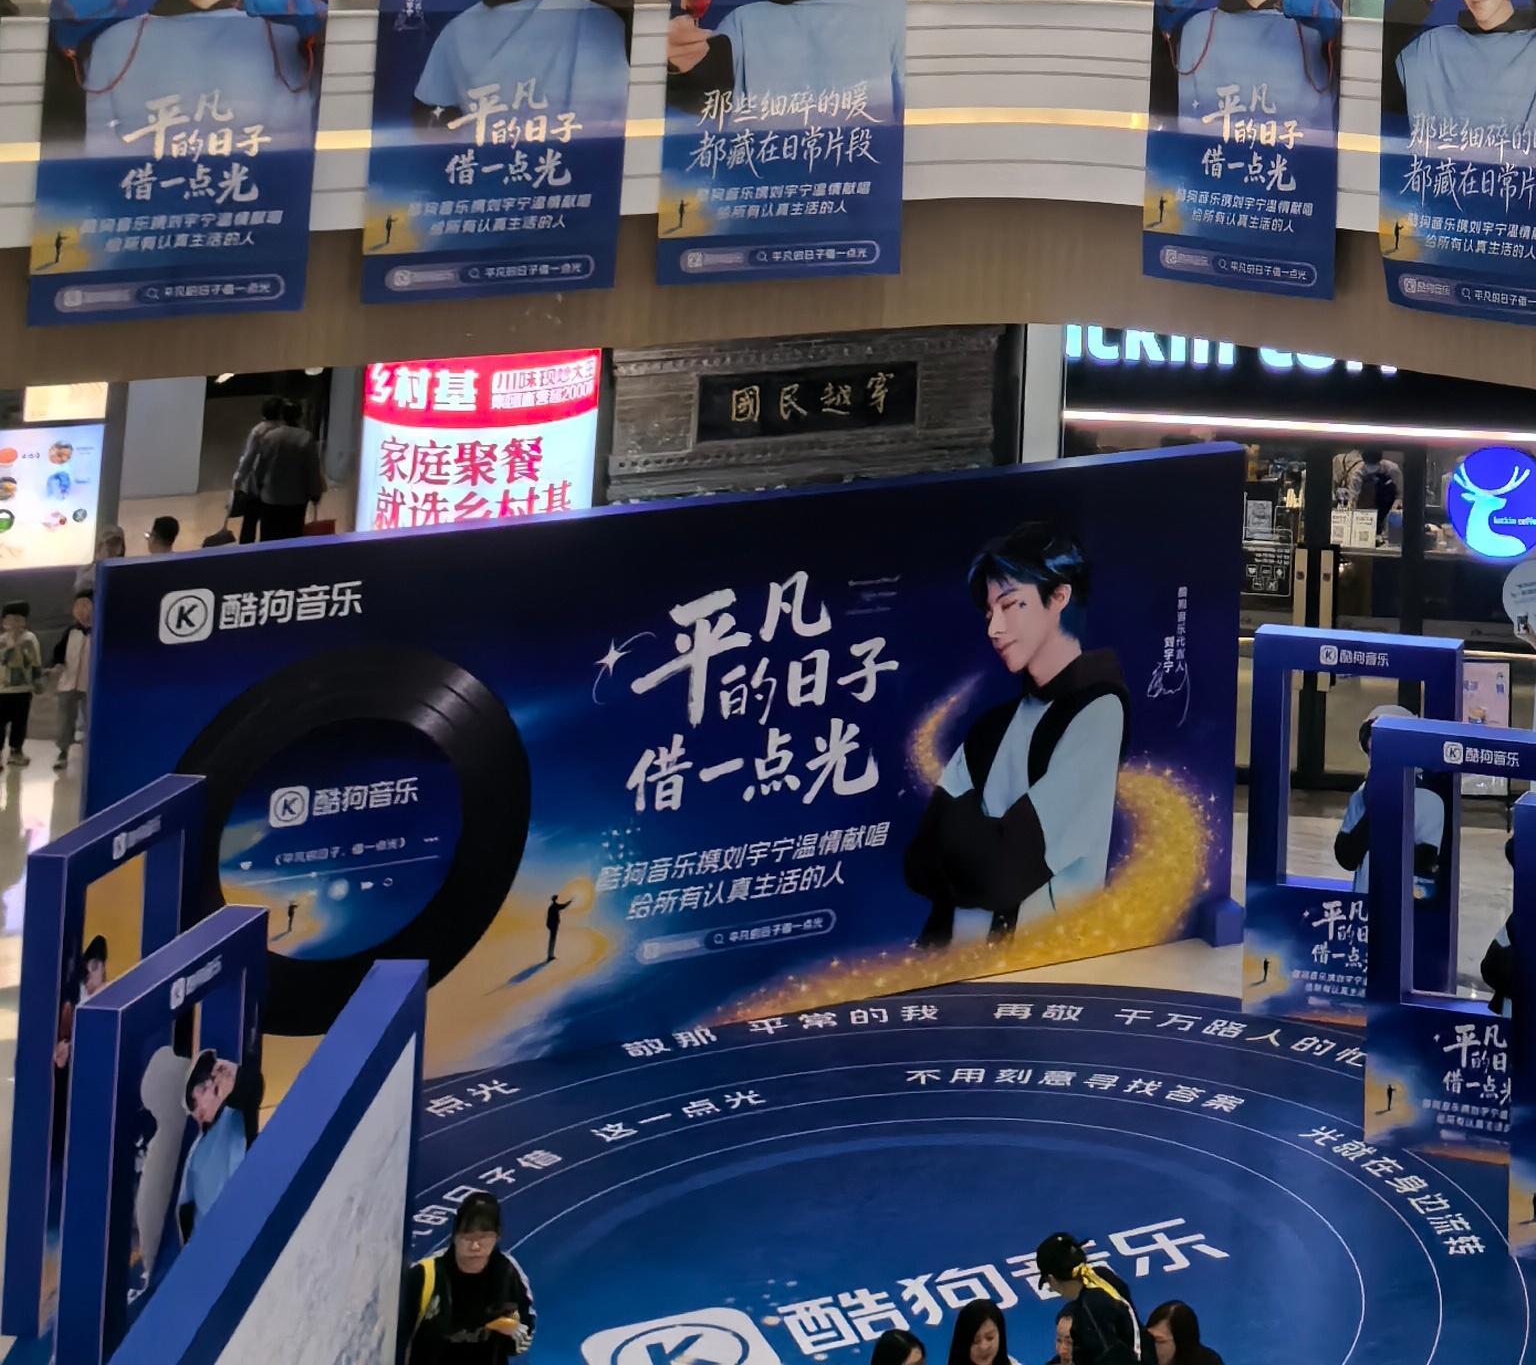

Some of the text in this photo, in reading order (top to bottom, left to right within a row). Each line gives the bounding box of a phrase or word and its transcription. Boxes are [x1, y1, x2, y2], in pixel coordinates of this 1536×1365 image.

[125, 90, 234, 160] 平凡
[448, 77, 548, 146] 平凡
[698, 80, 883, 127] 那些细碎的暖
[1202, 84, 1276, 143] 平凡
[171, 125, 271, 162] 的日子
[492, 111, 582, 147] 的日子
[687, 125, 882, 178] 都藏在日常片段
[1235, 120, 1304, 149] 的日子
[121, 165, 258, 203] 借一点光
[445, 149, 571, 188] 借一点光
[1202, 148, 1296, 191] 借一点光
[1192, 208, 1294, 233] 给所有认真生活的人
[1425, 233, 1536, 259] 给所有认真生活的人
[369, 363, 478, 411] 乡村基
[380, 436, 544, 487] 家庭聚餐
[219, 580, 362, 632] 酷狗音乐
[631, 571, 832, 727] 平凡
[720, 637, 898, 725] 的日子
[626, 718, 879, 812] 借一点光
[1466, 748, 1519, 767] 酷狗音乐
[312, 777, 418, 816] 酷狗音乐
[597, 821, 891, 892] 酷狗音乐携刘宇宁温情献唱
[626, 861, 846, 920] 给所有认真生活的人
[1312, 900, 1368, 940] 平凡
[622, 1028, 715, 1059] 敬那
[748, 1004, 937, 1035] 平常的我
[994, 1003, 1082, 1022] 再敬
[1444, 1024, 1507, 1069] 平凡
[425, 1079, 521, 1117] 点光
[906, 1067, 1246, 1114] 不用刻意寻找答案
[592, 1089, 767, 1143] 这一点光
[1298, 1125, 1486, 1256] 光就在身边流转
